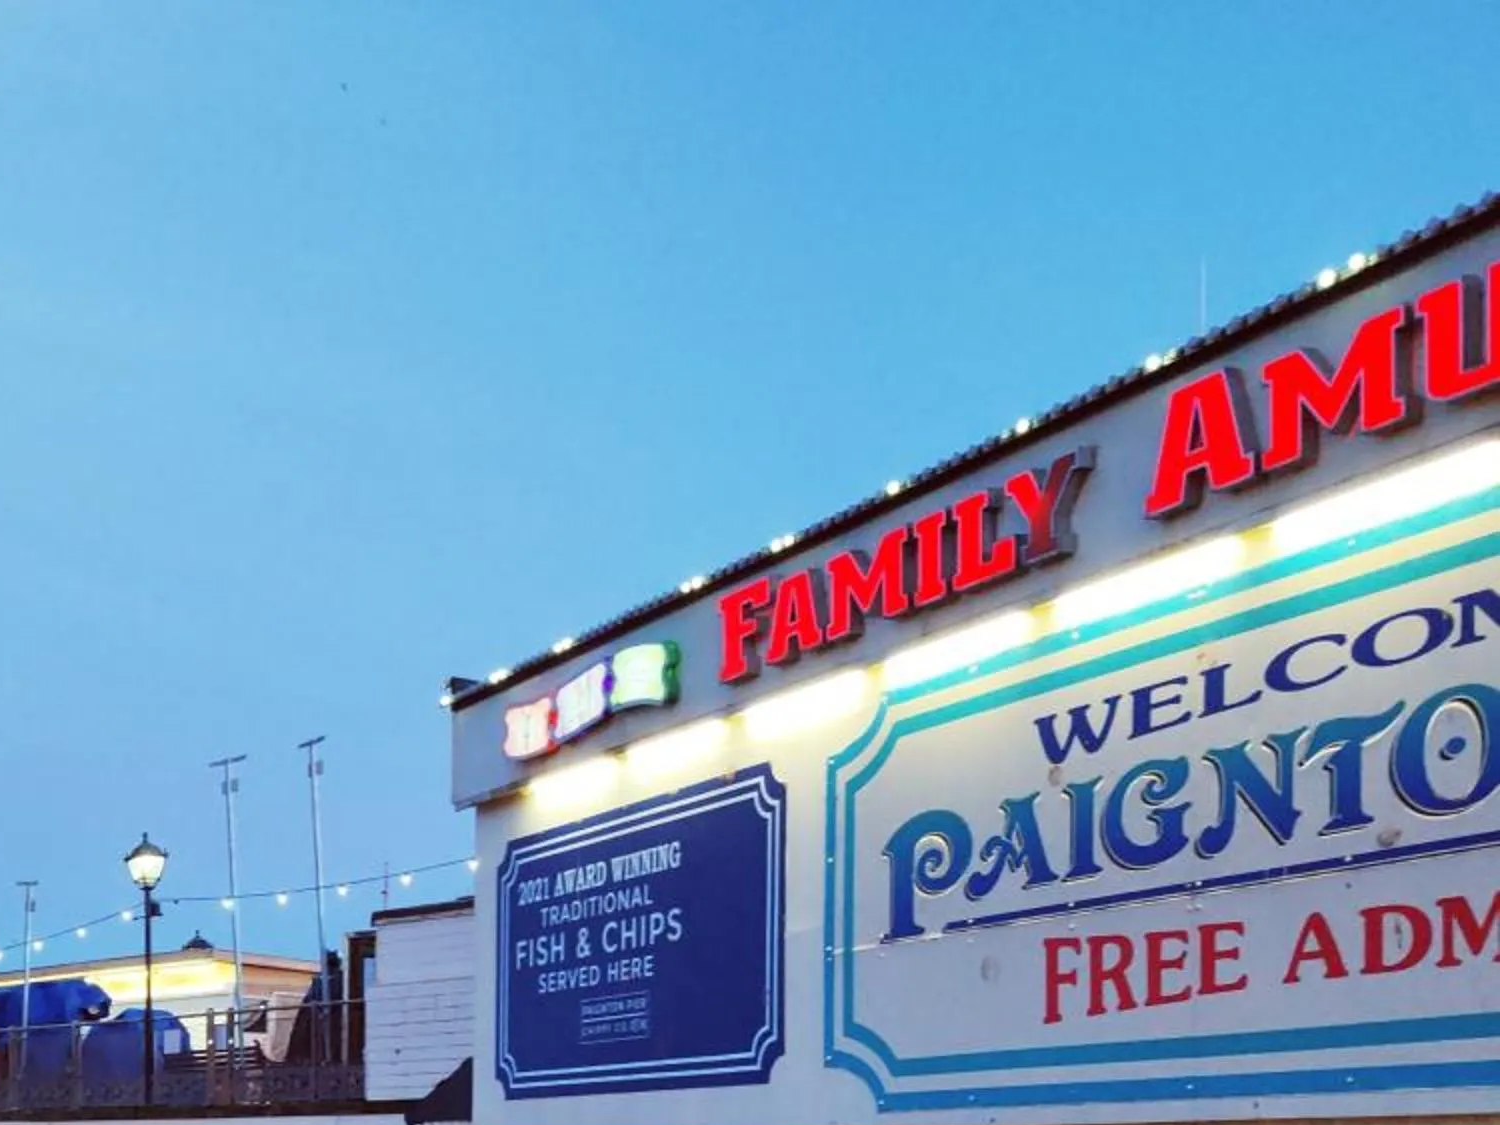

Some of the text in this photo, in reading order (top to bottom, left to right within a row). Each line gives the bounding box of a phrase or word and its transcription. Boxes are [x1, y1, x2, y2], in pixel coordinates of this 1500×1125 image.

[717, 260, 1500, 683] FAMILY AMU
[880, 683, 1500, 944] PAIGNTO
[517, 840, 682, 906] 2021 AWARD WINNING
[539, 884, 653, 928] TRADITIONAL
[515, 907, 683, 971] FISH & CHIPS
[537, 955, 655, 994] SERVED HERE
[1043, 920, 1249, 1025] FREE
